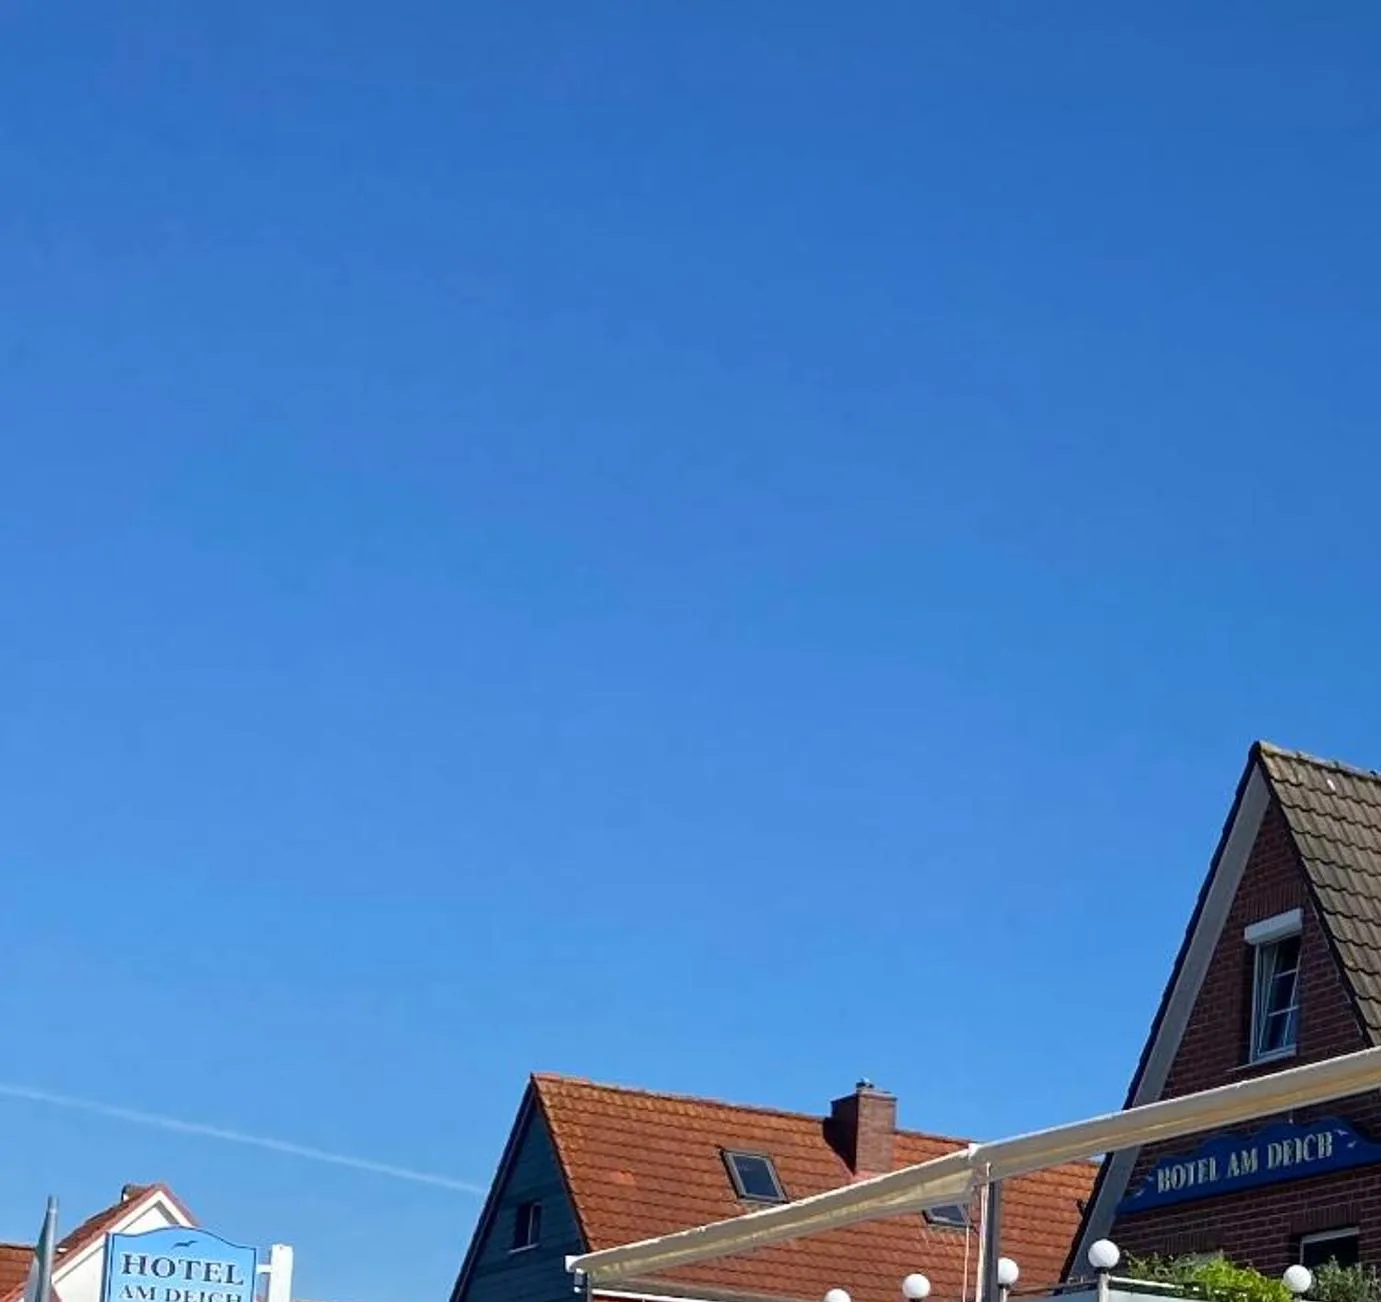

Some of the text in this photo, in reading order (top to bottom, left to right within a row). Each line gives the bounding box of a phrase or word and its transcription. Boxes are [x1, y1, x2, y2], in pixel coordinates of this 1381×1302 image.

[1157, 1131, 1333, 1194] HOTEL AM DEICH
[121, 1253, 244, 1285] HOTEL
[119, 1285, 157, 1301] AM
